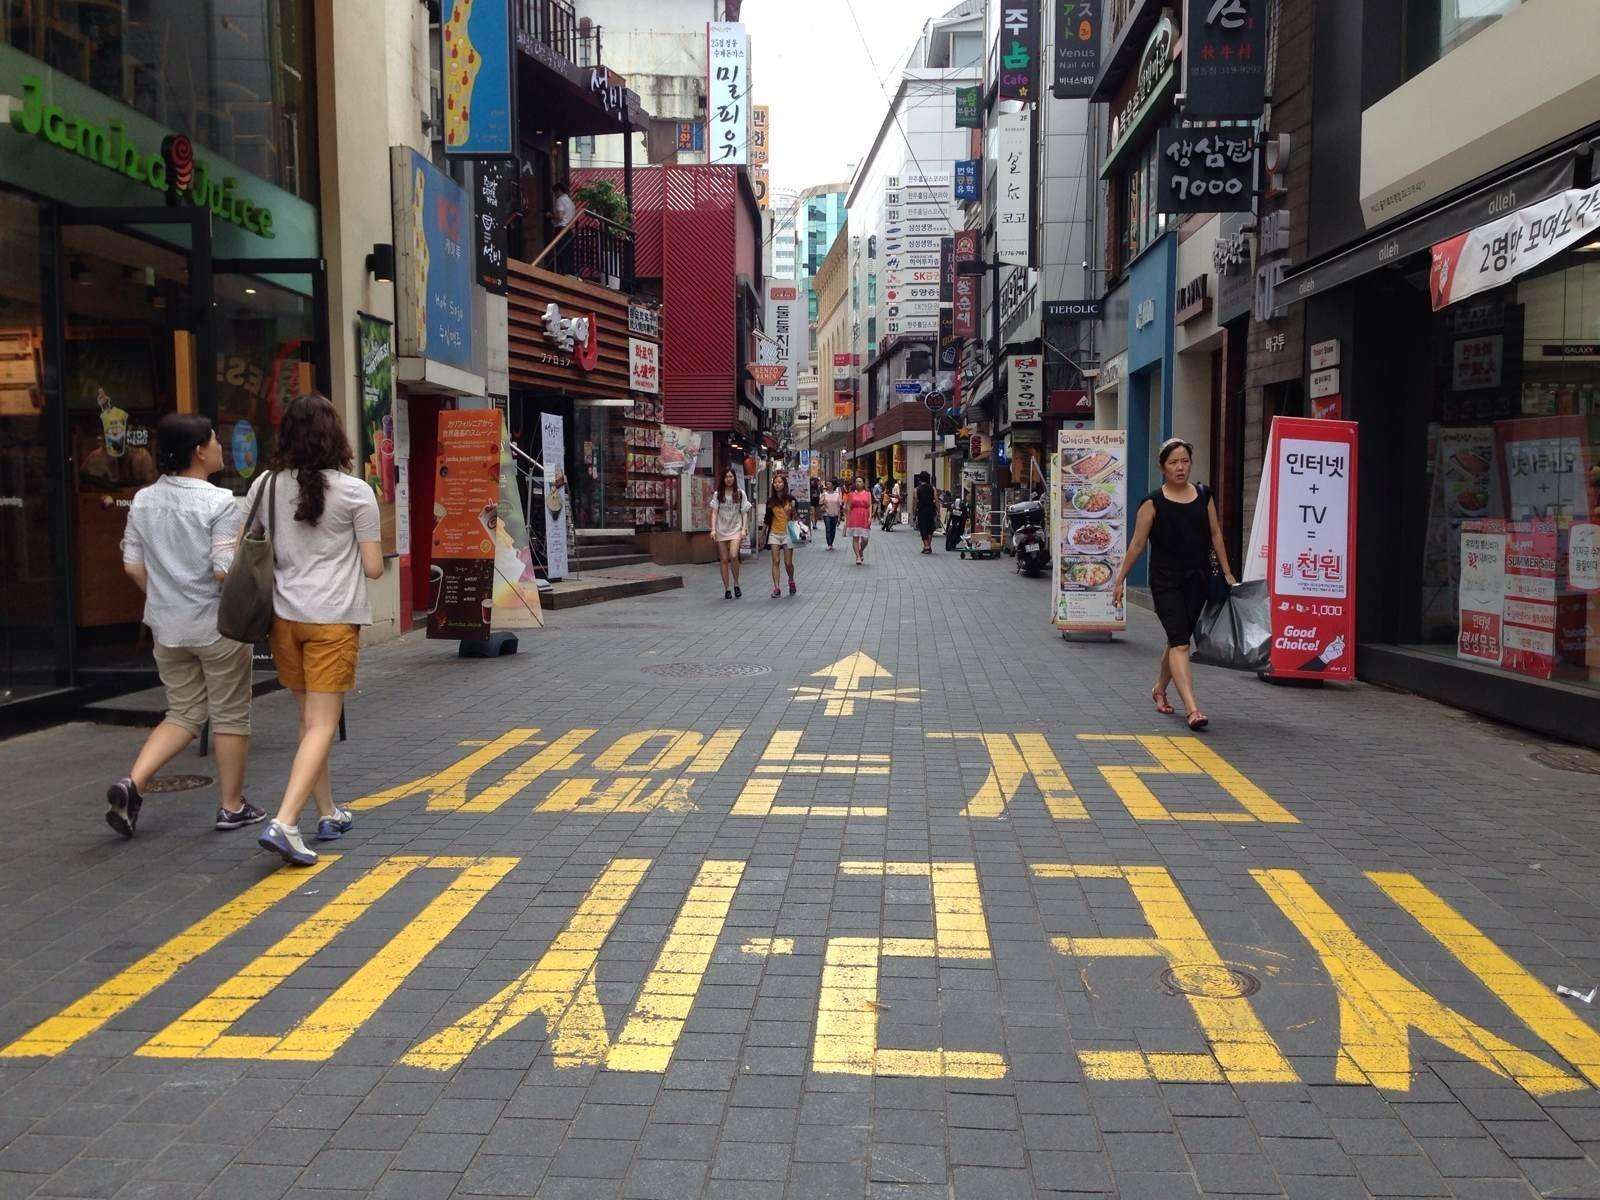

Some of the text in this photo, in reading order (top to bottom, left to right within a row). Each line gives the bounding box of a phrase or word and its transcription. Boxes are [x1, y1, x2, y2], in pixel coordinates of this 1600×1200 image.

[1059, 48, 1096, 58] Venus
[1059, 61, 1095, 69] Nail Art
[1002, 74, 1029, 86] Cafe
[1059, 75, 1095, 85] 비너스네일
[10, 75, 275, 239] Jamba Juice
[1171, 175, 1243, 200] 7000
[1488, 191, 1517, 215] olleh
[1378, 240, 1400, 261] olleh
[1479, 225, 1523, 273] 2명만
[1299, 279, 1315, 296] olleh
[1048, 304, 1099, 314] TIEHOLIC
[1564, 346, 1594, 355] GALAXY
[127, 429, 149, 438] KIDS
[127, 437, 149, 446] MENU
[1286, 453, 1344, 479] 인터넷
[1298, 505, 1328, 525] TV
[1297, 552, 1342, 581] 천원
[1508, 558, 1538, 569] SUMMER
[1311, 603, 1343, 617] 1,000
[1283, 624, 1317, 639] Good
[1275, 637, 1321, 652] Choice!
